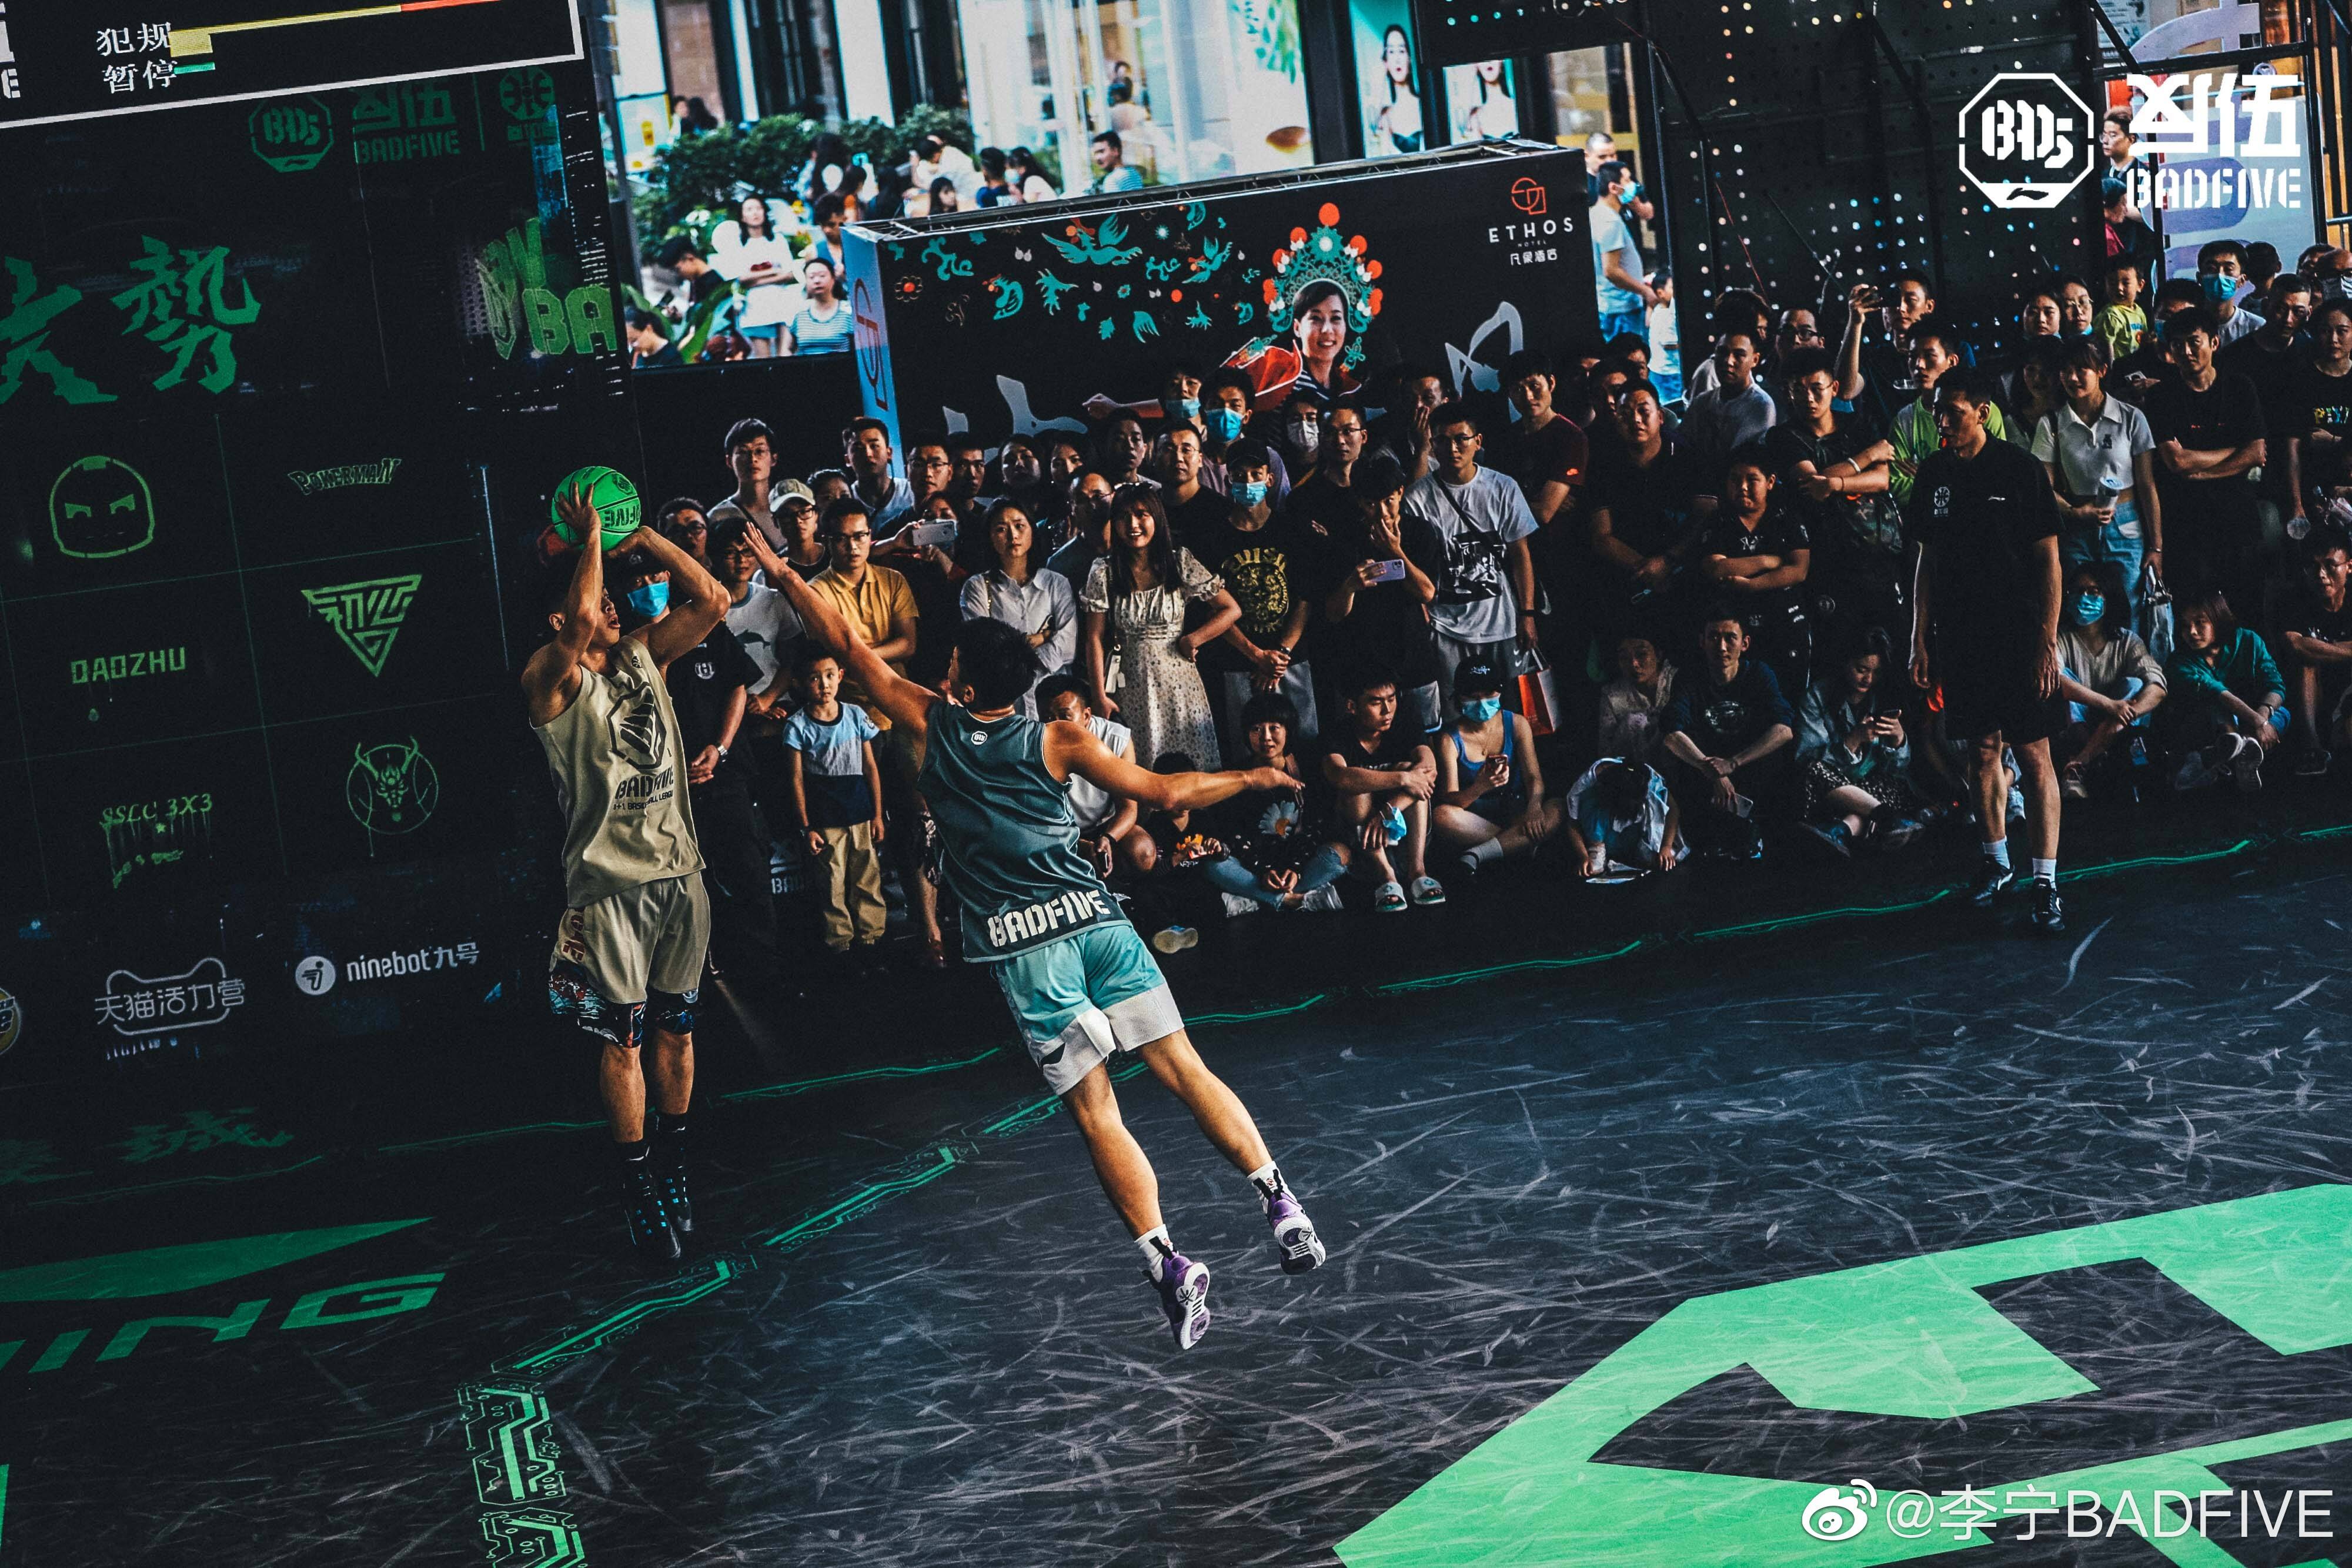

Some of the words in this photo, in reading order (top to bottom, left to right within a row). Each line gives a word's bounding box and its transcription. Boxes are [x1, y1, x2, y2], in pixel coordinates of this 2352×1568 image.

[96, 21, 172, 56] 犯规
[102, 59, 178, 94] 暂停
[354, 128, 460, 166] BADFIVE
[1488, 216, 1574, 244] ETHOS
[987, 889, 1111, 948] BADFIVE
[346, 948, 432, 982] ninebot
[433, 941, 480, 969] 九号
[94, 978, 246, 1025] 天猫活力营
